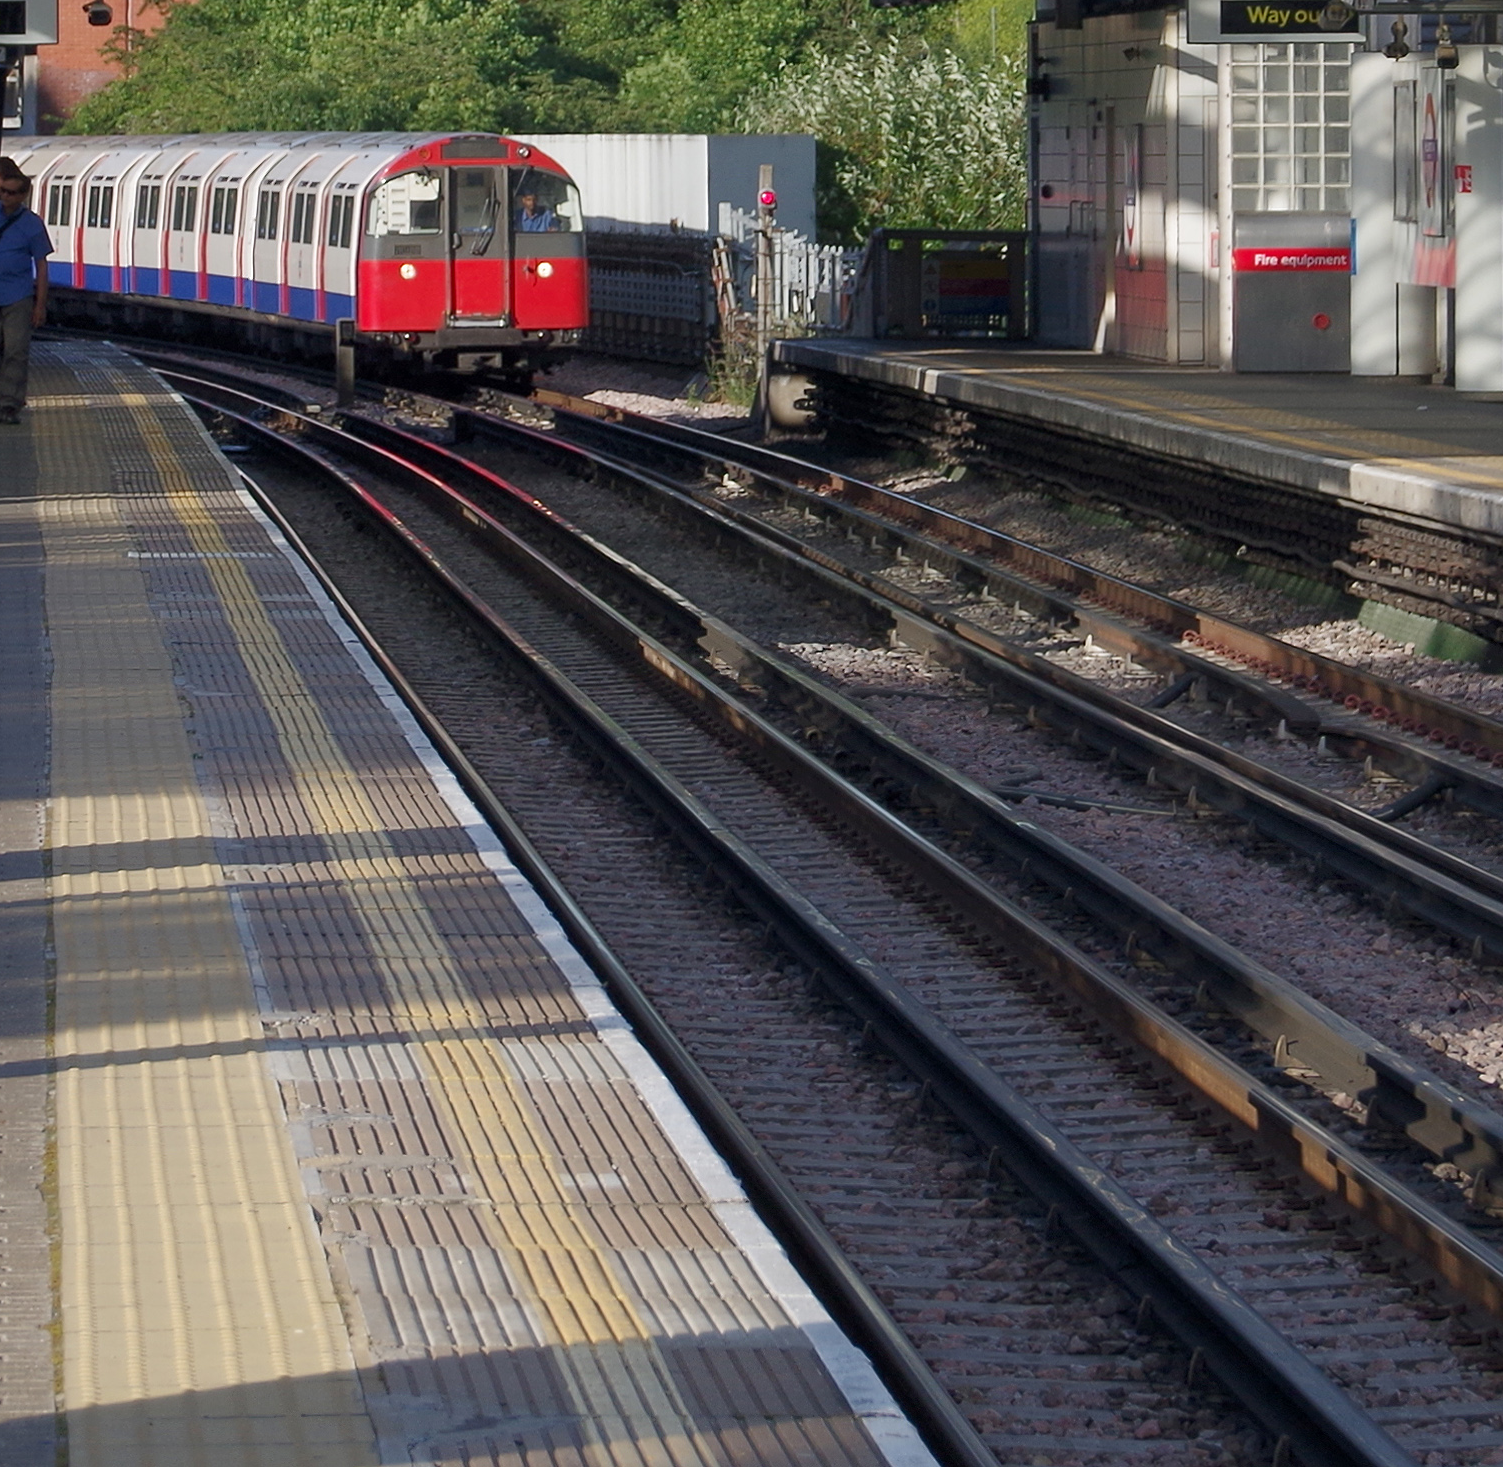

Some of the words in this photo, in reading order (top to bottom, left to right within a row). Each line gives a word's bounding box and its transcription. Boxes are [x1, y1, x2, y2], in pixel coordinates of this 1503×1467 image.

[1247, 5, 1290, 27] Way
[1294, 10, 1322, 23] ou
[1254, 254, 1278, 265] Fire
[1281, 254, 1347, 268] equipment
